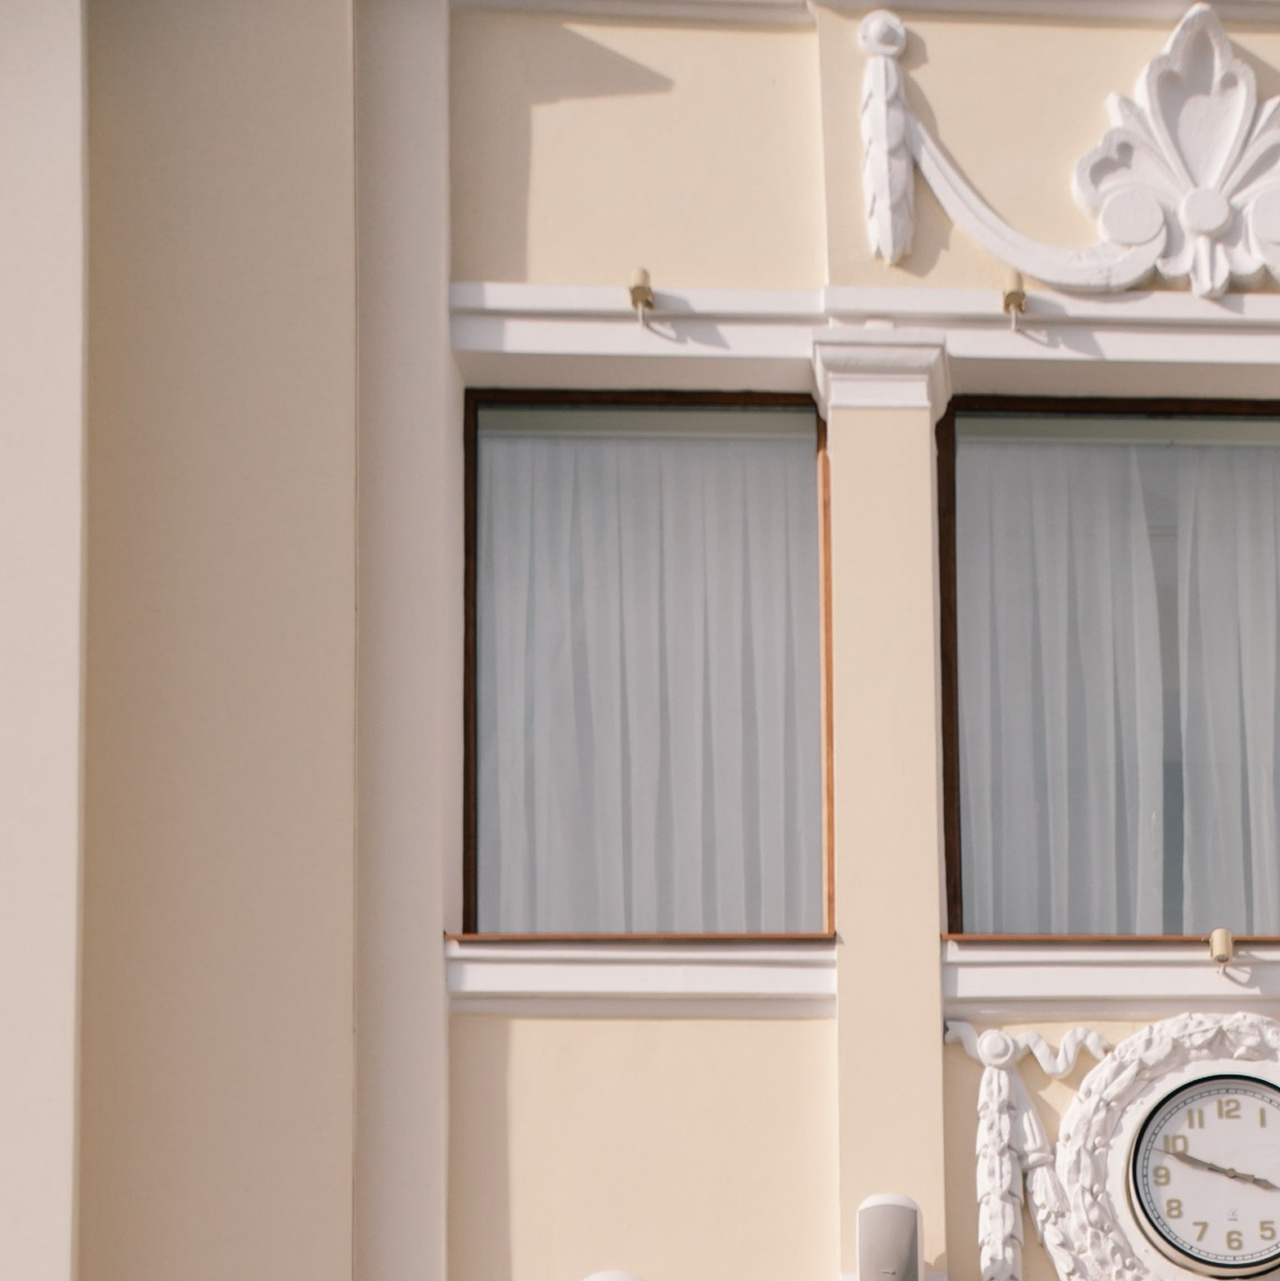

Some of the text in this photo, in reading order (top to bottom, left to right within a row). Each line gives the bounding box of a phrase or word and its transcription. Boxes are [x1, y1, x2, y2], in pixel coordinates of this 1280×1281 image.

[1187, 1109, 1205, 1129] 11
[1216, 1099, 1241, 1119] 12
[1259, 1108, 1266, 1127] 1
[1163, 1134, 1189, 1154] 10
[1152, 1165, 1170, 1186] 9
[1166, 1199, 1183, 1219] 8
[1192, 1221, 1208, 1242] 7
[1226, 1230, 1243, 1251] 6
[1259, 1220, 1276, 1241] 5
